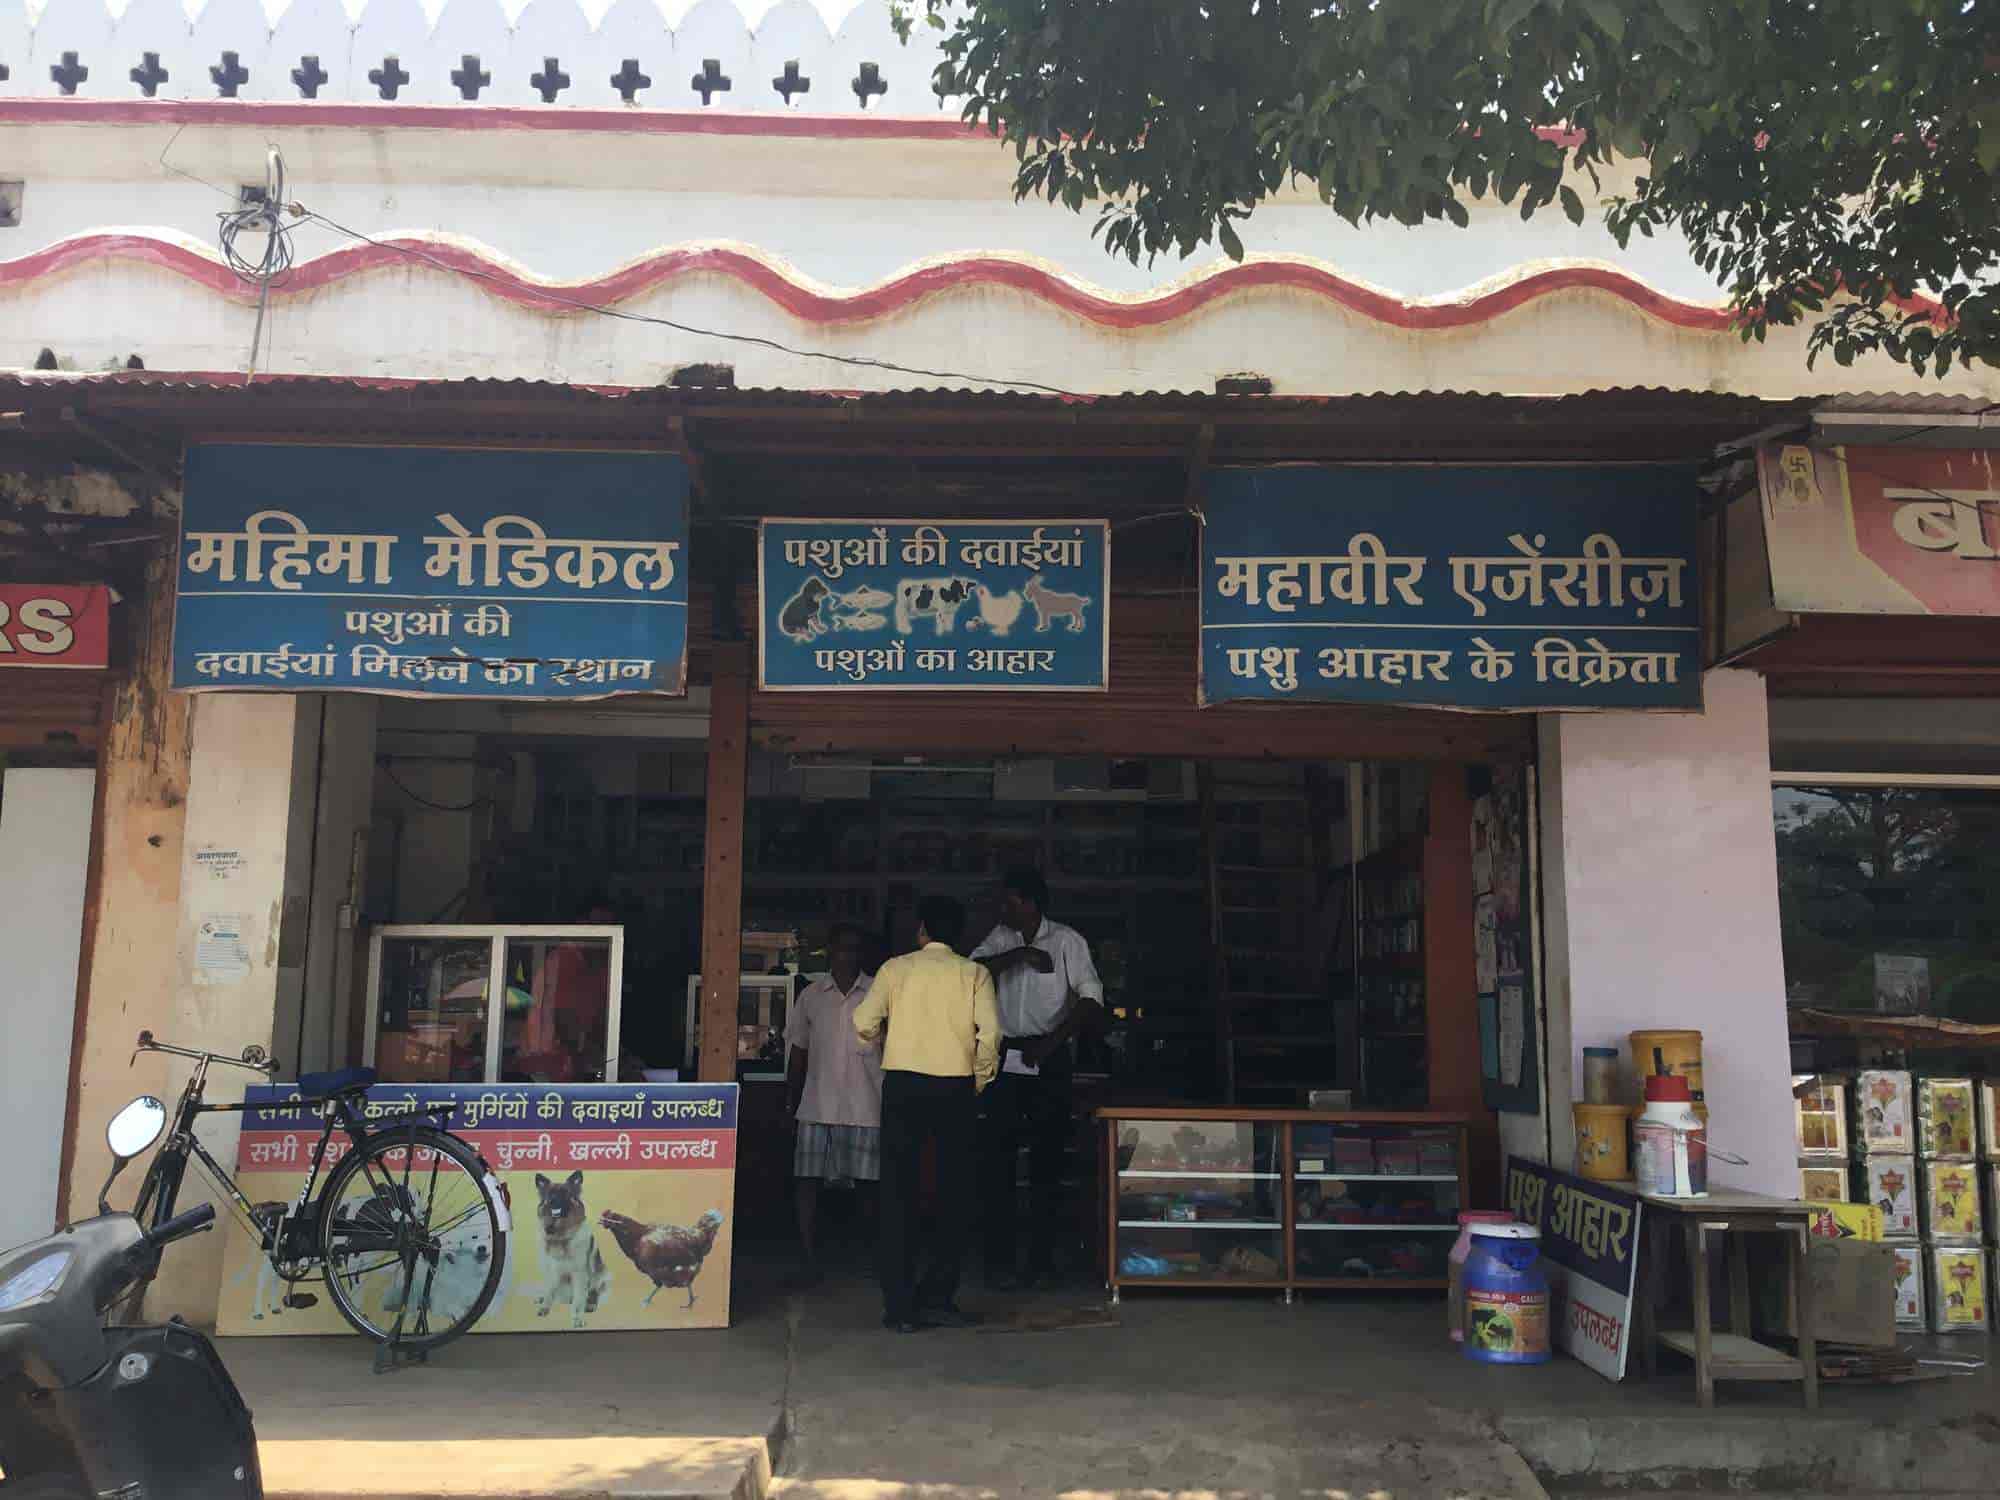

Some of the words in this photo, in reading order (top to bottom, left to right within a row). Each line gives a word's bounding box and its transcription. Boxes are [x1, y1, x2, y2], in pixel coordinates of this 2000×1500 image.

[186, 510, 399, 590] महिमा
[423, 513, 680, 591] मेडिकल
[784, 527, 890, 578] पशुओं
[901, 526, 950, 568] की
[959, 528, 1085, 571] दवाईयां
[1215, 533, 1427, 612] महावीर
[1448, 534, 1688, 618] एजेंसीज़
[345, 601, 453, 643] पशुओं
[464, 604, 513, 637] की
[194, 643, 338, 679] दवाईयां
[349, 644, 473, 685] मिलने
[481, 656, 541, 685] का
[545, 658, 656, 686] स्थान
[814, 640, 906, 680] पशुओं
[915, 649, 956, 673] का
[967, 649, 1057, 675] आहार
[1226, 646, 1301, 691] पशु
[1318, 648, 1452, 684] आहार
[1467, 637, 1516, 682] के
[1532, 637, 1682, 687] विक्रेता
[463, 1092, 531, 1128] मुर्गियों
[536, 1093, 565, 1120] की
[571, 1092, 645, 1123] दवाइयाँ
[651, 1098, 726, 1120] उपलब्ध
[249, 1134, 300, 1162] सभी
[640, 1140, 719, 1161] उपलब्ध
[1551, 1182, 1632, 1262] आहार
